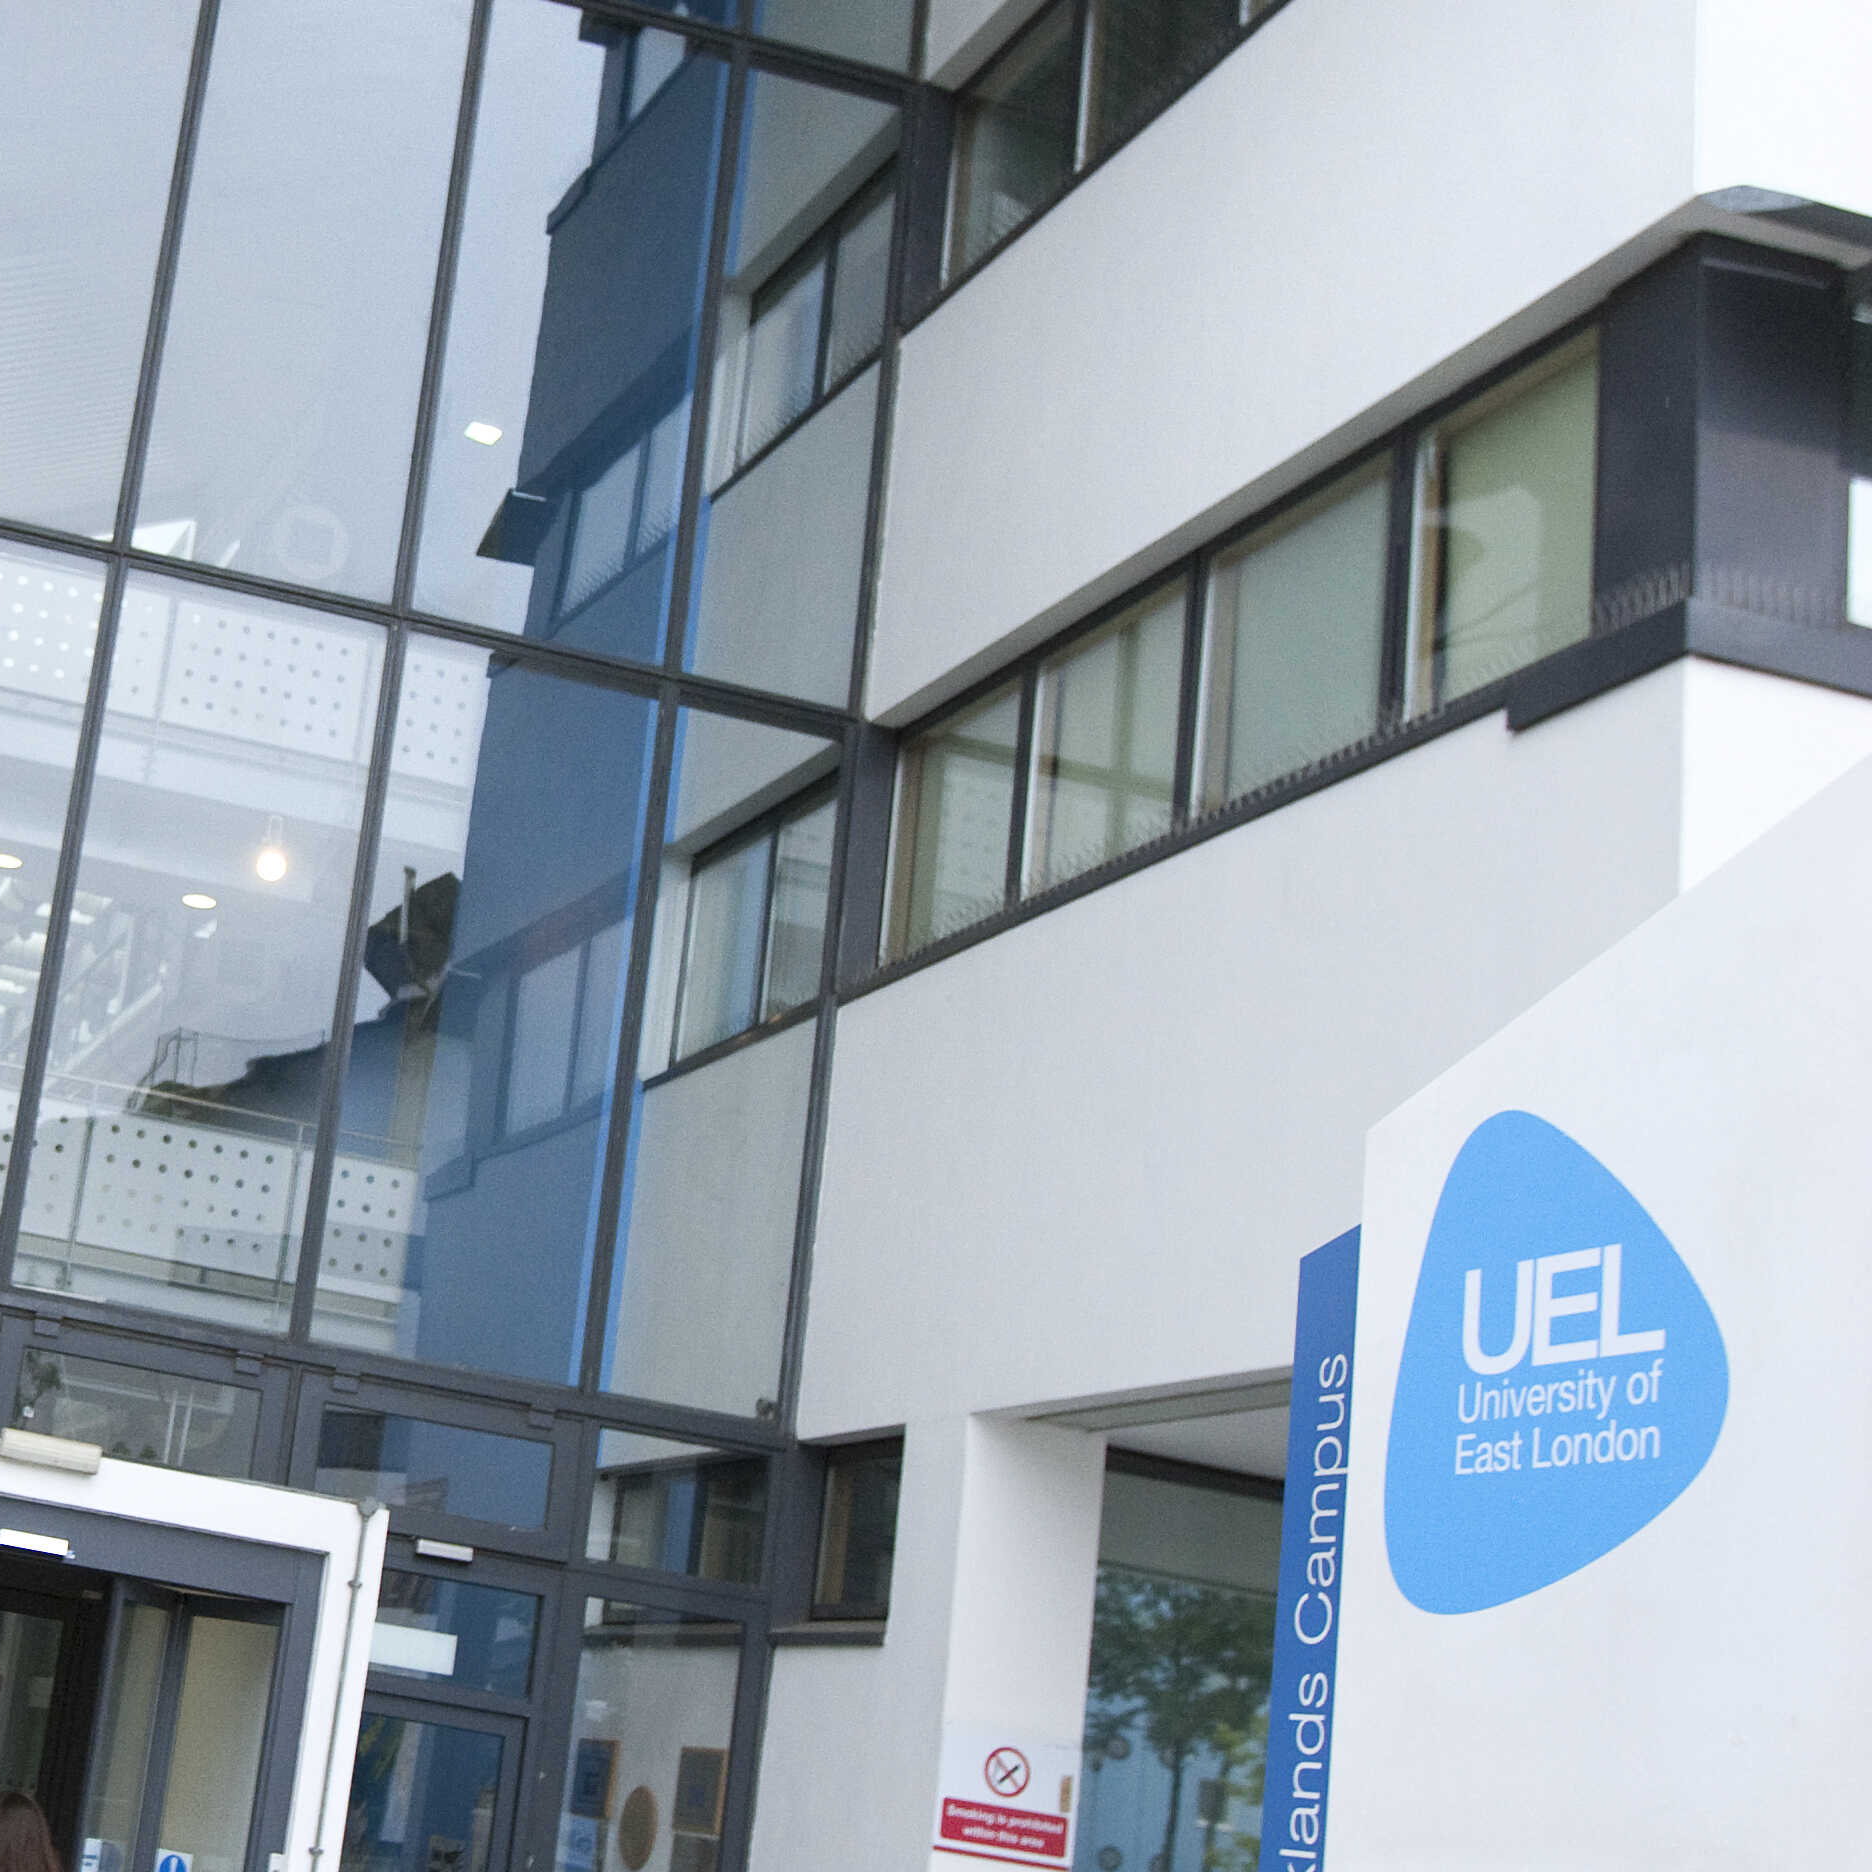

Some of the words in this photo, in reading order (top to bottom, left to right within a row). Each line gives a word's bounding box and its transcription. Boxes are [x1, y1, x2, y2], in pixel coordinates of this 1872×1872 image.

[1462, 1243, 1666, 1375] UEL
[1456, 1370, 1616, 1424] University
[1626, 1359, 1664, 1406] of
[1454, 1431, 1523, 1475] East
[1532, 1420, 1661, 1469] London
[1294, 1353, 1348, 1644] Campus
